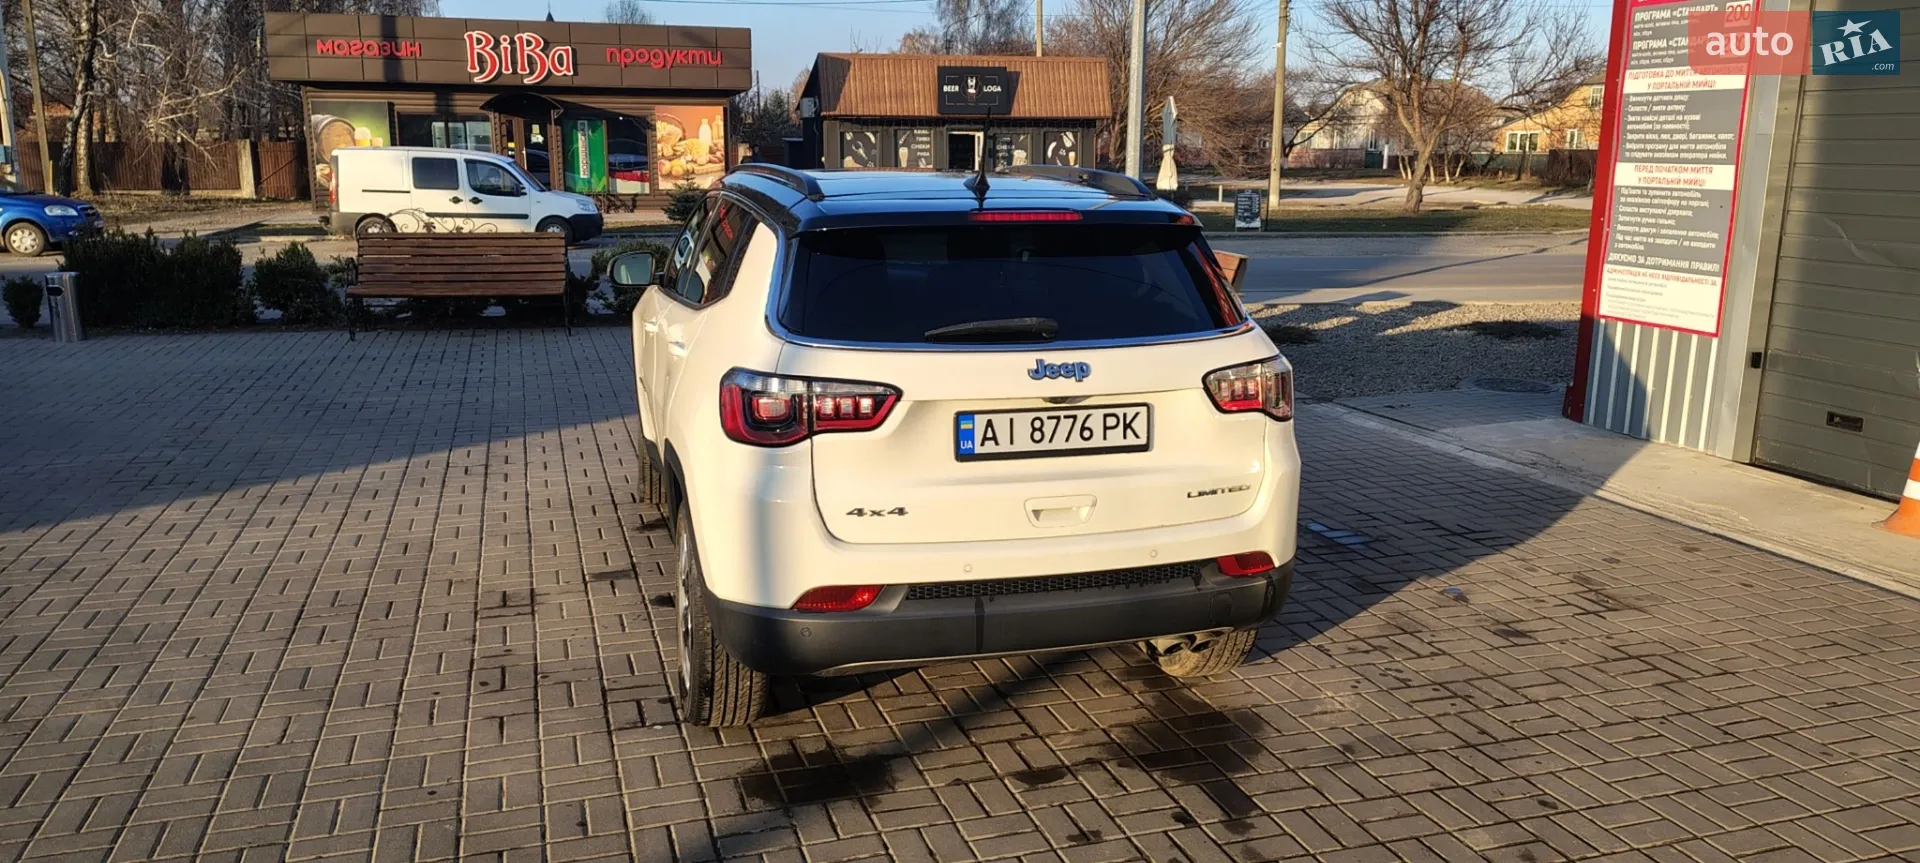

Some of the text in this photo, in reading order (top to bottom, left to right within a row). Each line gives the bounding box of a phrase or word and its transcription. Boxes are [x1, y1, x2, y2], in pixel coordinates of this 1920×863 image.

[1634, 9, 1671, 22] ПРОГРАМА
[1725, 3, 1751, 23] 200
[316, 39, 422, 58] магазин
[1632, 38, 1668, 51] ПРОГРАМА
[605, 47, 723, 69] продукти
[1628, 69, 1664, 80] ПІДГОТОВКА
[1665, 68, 1674, 78] ДО
[1652, 79, 1691, 89] ПОРТАЛЬНІЙ
[1634, 164, 1713, 175] ПЕРЕД ПОЧАТКОМ МИТТЯ
[1642, 176, 1681, 186] ПОРТАЛЬНІЙ
[1608, 252, 1637, 263] ДЯКУЄМО
[1637, 255, 1645, 264] ЗА
[1645, 256, 1690, 269] ДОТРИМАННЯ
[1027, 358, 1092, 383] Jeep
[979, 411, 1142, 448] AI 8776 PK
[960, 440, 974, 451] UA
[1186, 484, 1251, 499] LIMITED
[845, 506, 909, 518] 4x4
